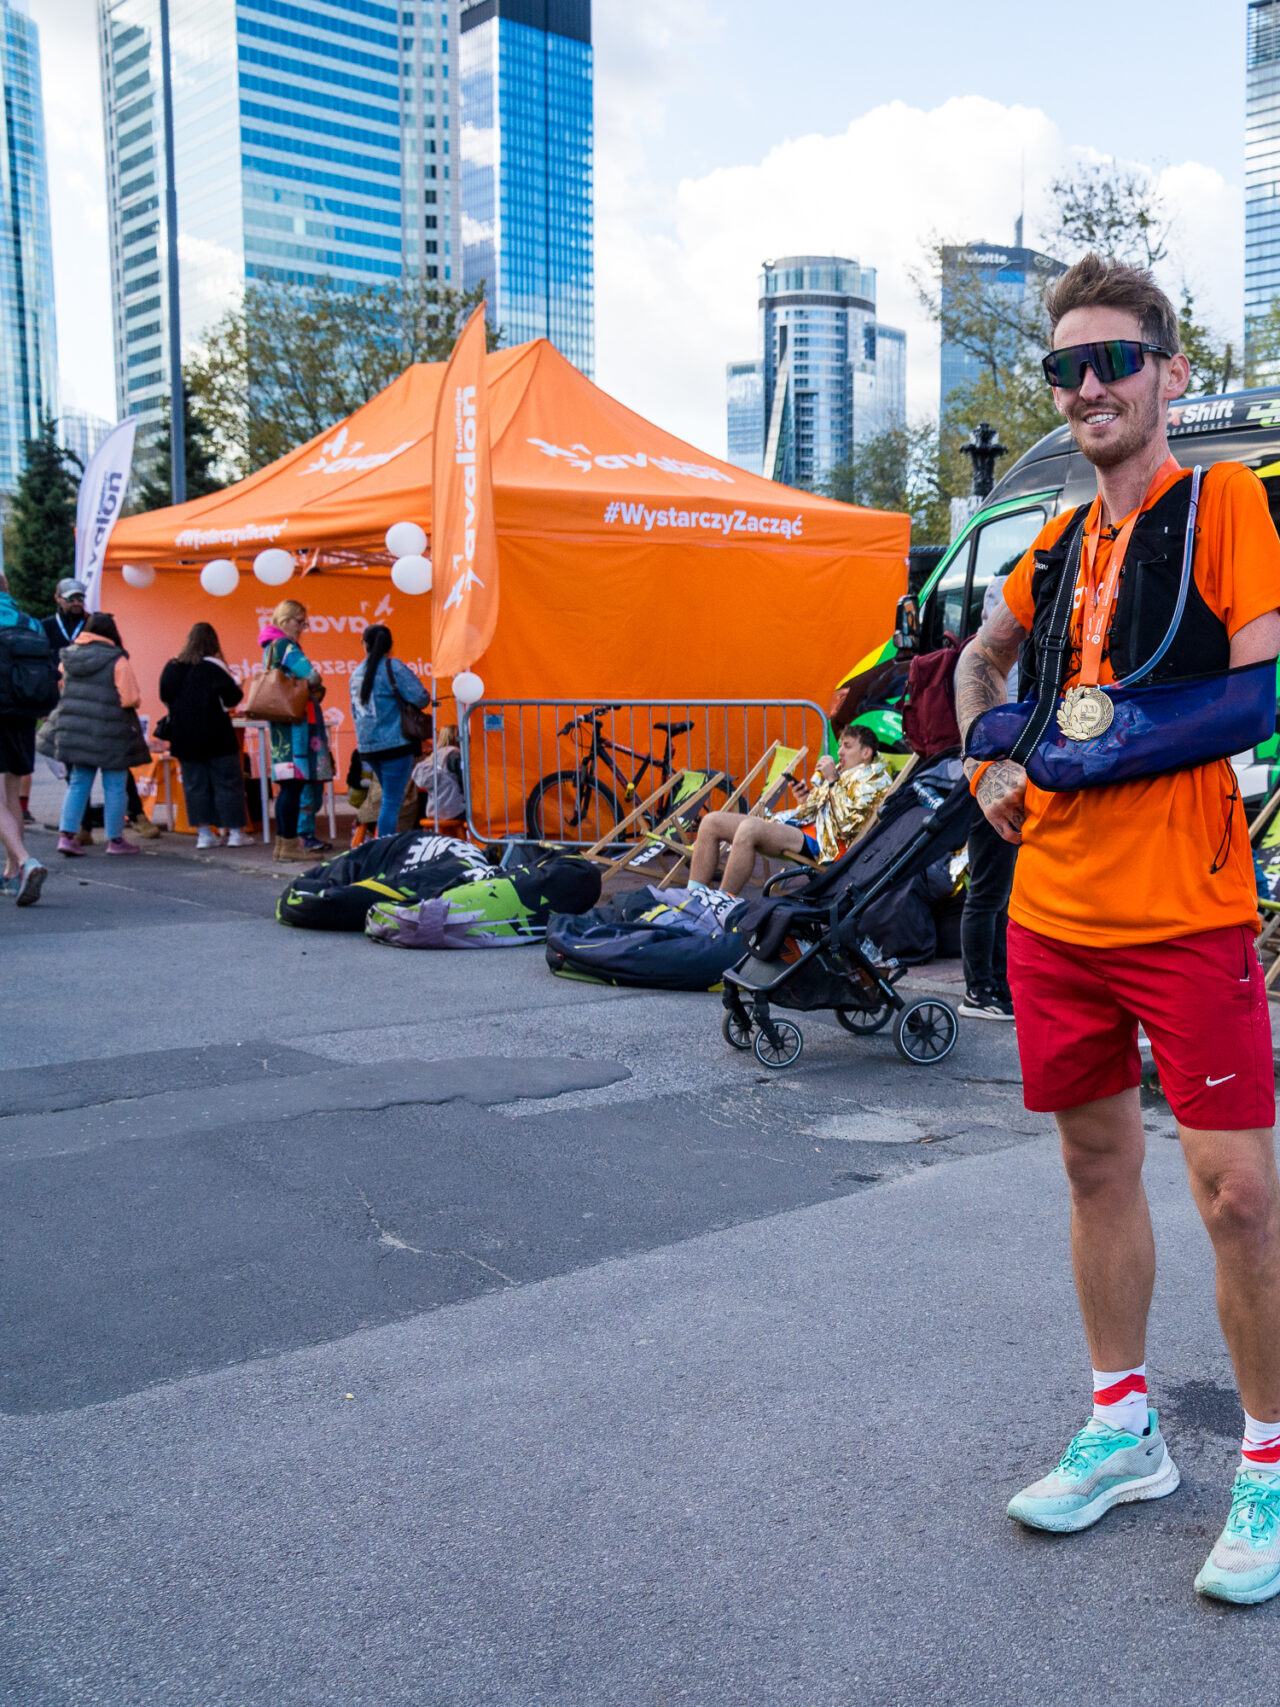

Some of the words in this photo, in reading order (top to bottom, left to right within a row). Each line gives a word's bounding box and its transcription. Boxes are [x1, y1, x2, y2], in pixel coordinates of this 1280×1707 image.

[1182, 400, 1236, 424] Shift
[455, 385, 477, 561] avalon
[603, 501, 803, 539] #WystarczyZacząć
